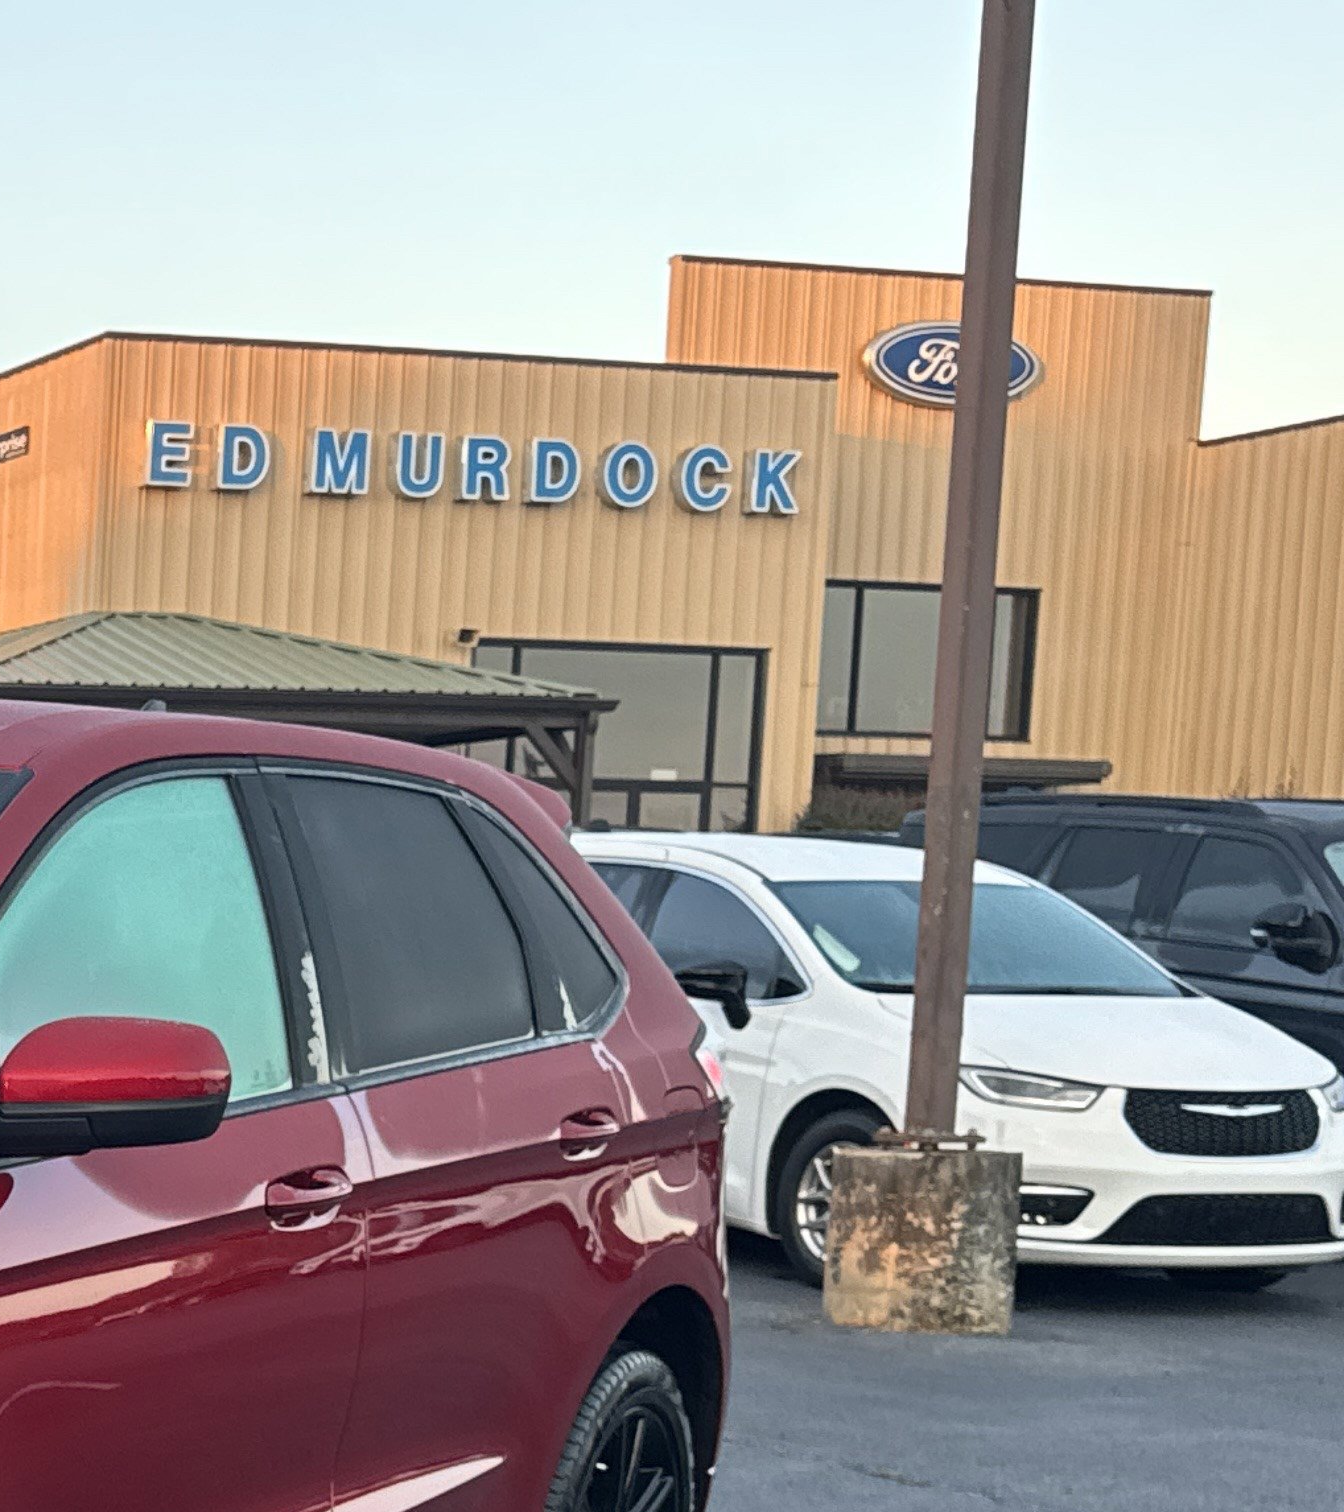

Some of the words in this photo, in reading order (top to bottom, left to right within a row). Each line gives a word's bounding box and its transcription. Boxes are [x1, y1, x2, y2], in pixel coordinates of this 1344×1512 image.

[908, 337, 960, 385] Fo
[146, 419, 270, 490] ED
[311, 427, 802, 515] MURDOCK
